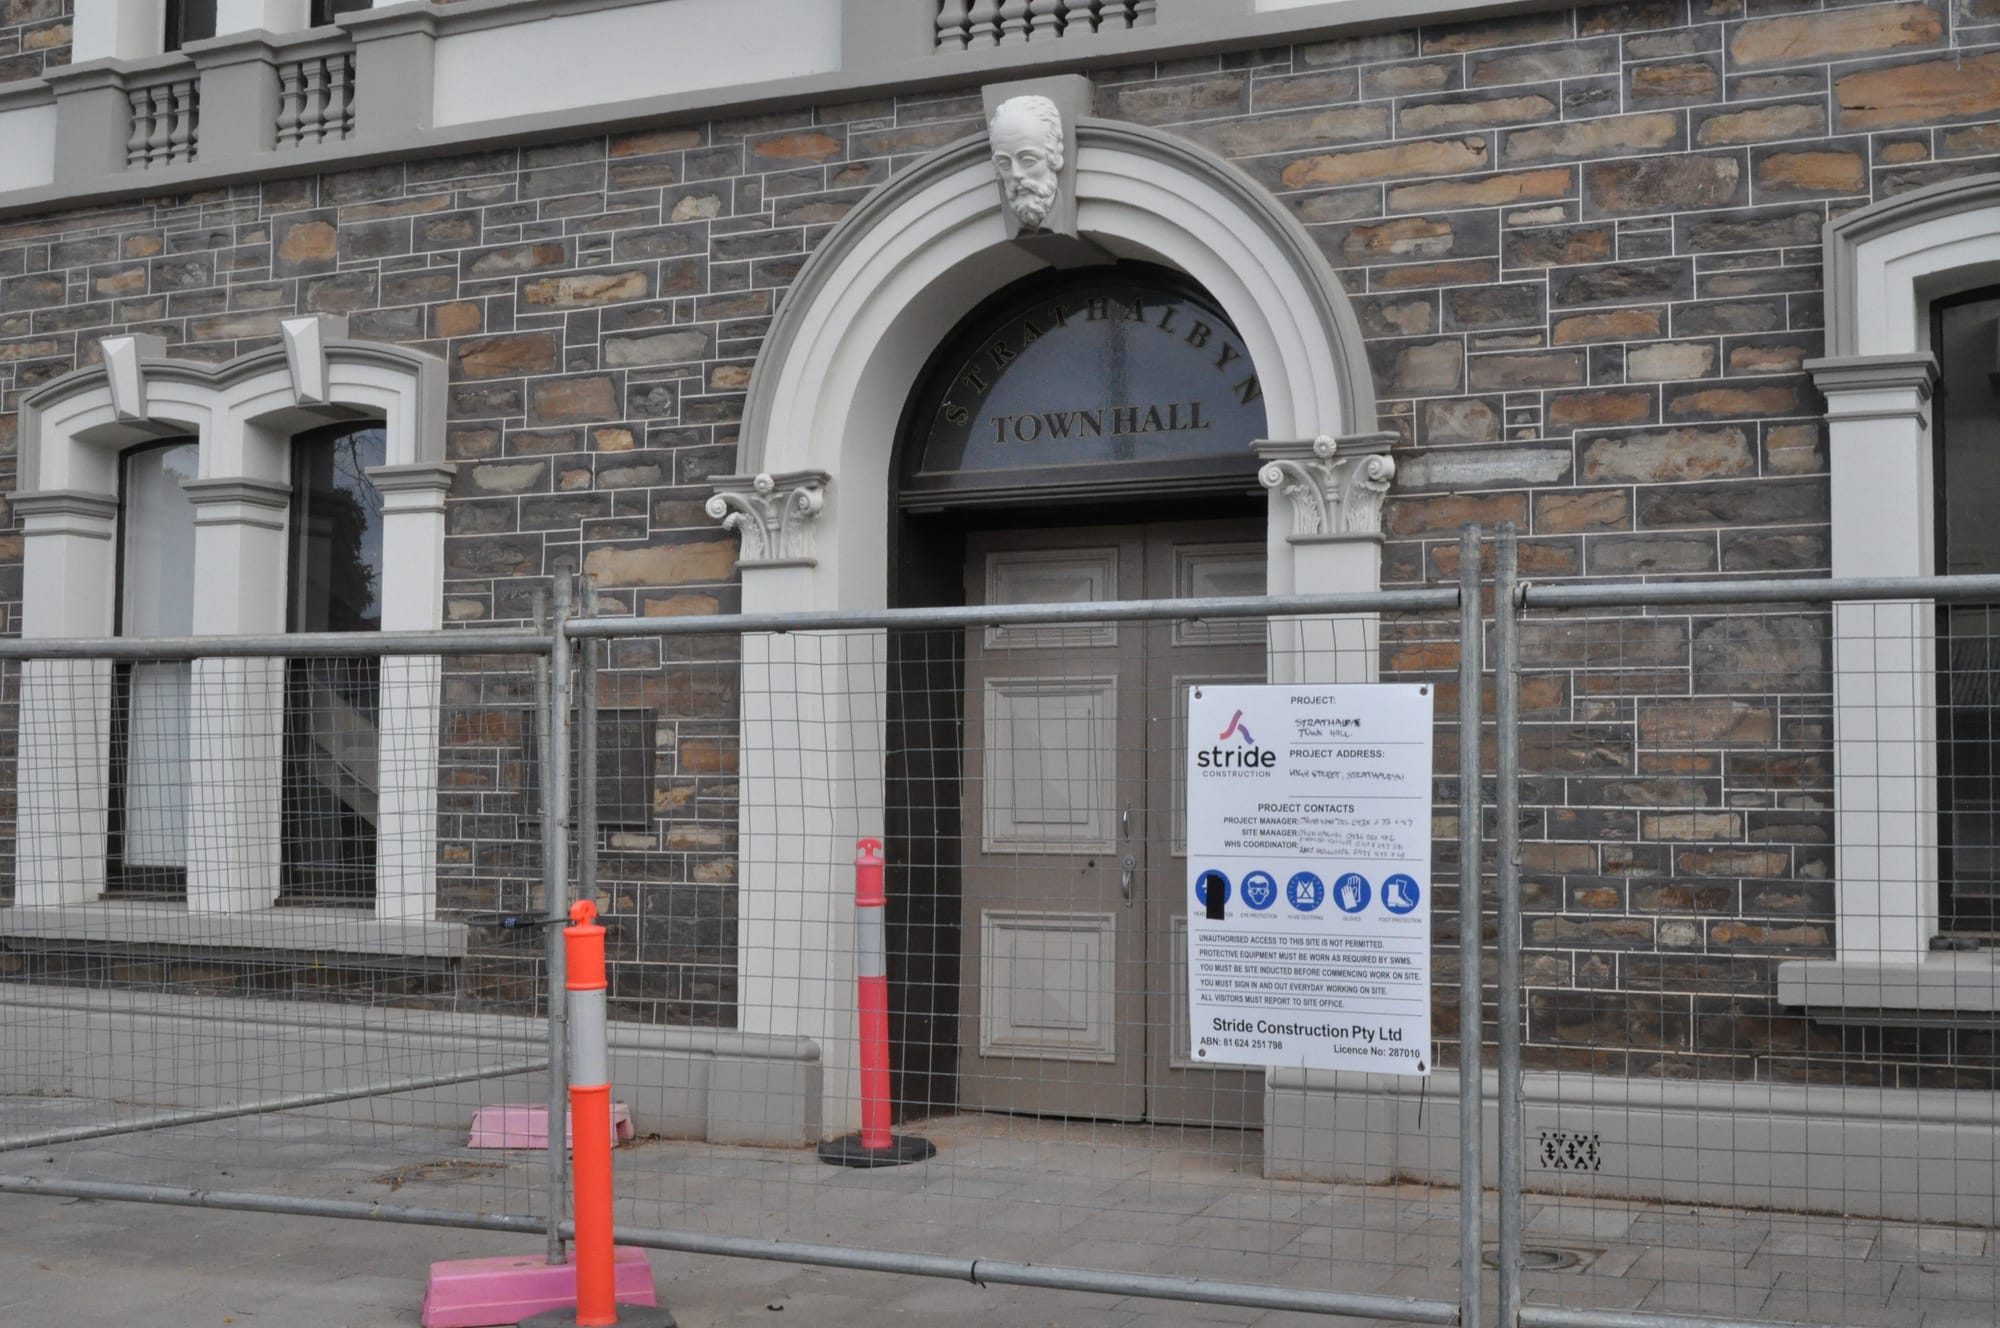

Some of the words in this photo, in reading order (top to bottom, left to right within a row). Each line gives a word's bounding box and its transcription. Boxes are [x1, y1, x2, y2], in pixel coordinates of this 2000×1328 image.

[946, 297, 1263, 426] STRATHALBYN
[990, 409, 1105, 444] TOWN
[1111, 401, 1210, 436] HALL
[1290, 696, 1336, 705] PROJECT:
[1197, 745, 1277, 768] stride
[1289, 749, 1333, 758] PROJECT
[1336, 749, 1385, 758] ADDRESS:
[1202, 770, 1271, 778] CONSTRUCTION
[1257, 803, 1301, 813] PROJECT
[1303, 803, 1355, 814] CONTACTS
[1223, 816, 1258, 825] PROJECT
[1259, 817, 1299, 825] MANAGER:
[1241, 828, 1258, 836] SITE
[1259, 829, 1299, 837] MANAGER:
[1224, 840, 1241, 848] WHS
[1243, 840, 1299, 849] COORDINATOR:
[1199, 934, 1249, 944] UNAUTHORISED
[1250, 936, 1277, 945] ACCESS
[1278, 937, 1288, 945] TO
[1289, 937, 1304, 946] THIS
[1305, 938, 1320, 946] SITE
[1321, 938, 1328, 947] IS
[1329, 939, 1343, 947] NOT
[1345, 939, 1385, 949] PERMITTED.
[1199, 948, 1239, 958] PROTECTIVE
[1240, 950, 1277, 960] EQUIPMENT
[1278, 952, 1297, 960] MUST
[1298, 953, 1308, 961] BE
[1309, 953, 1330, 962] WORN
[1331, 954, 1341, 962] AS
[1342, 954, 1377, 964] REQUIRED
[1378, 956, 1389, 964] BY
[1200, 963, 1214, 972] YOU
[1214, 964, 1232, 973] MUST
[1233, 965, 1243, 973] BE
[1244, 965, 1258, 974] SITE
[1259, 966, 1293, 975] INDUCTED
[1293, 967, 1321, 977] BEFORE
[1322, 968, 1368, 979] COMMENCING
[1369, 971, 1391, 980] WORK
[1392, 972, 1403, 980] ON
[1200, 978, 1214, 987] YOU
[1215, 979, 1232, 988] MUST
[1234, 980, 1250, 988] SIGN
[1251, 981, 1258, 989] IN
[1259, 981, 1273, 990] AND
[1274, 982, 1288, 990] OUT
[1289, 982, 1324, 992] EVERYDAY
[1326, 984, 1358, 994] WORKING
[1360, 986, 1370, 994] ON
[1200, 993, 1213, 1001] ALL
[1214, 994, 1244, 1003] VISITORS
[1244, 995, 1263, 1004] MUST
[1264, 996, 1291, 1005] REPORT
[1292, 997, 1302, 1006] TO
[1303, 998, 1318, 1007] SITE
[1212, 1017, 1253, 1033] Stride
[1256, 1020, 1349, 1039] Construction
[1352, 1025, 1376, 1043] Pty
[1379, 1027, 1403, 1042] Ltd
[1200, 1036, 1222, 1046] ABN:
[1223, 1038, 1233, 1047] 81
[1234, 1038, 1249, 1048] 624
[1252, 1039, 1266, 1049] 251
[1267, 1040, 1283, 1050] 798
[1333, 1044, 1368, 1056] Licence
[1370, 1046, 1386, 1057] No:
[1388, 1047, 1421, 1058] 287010
